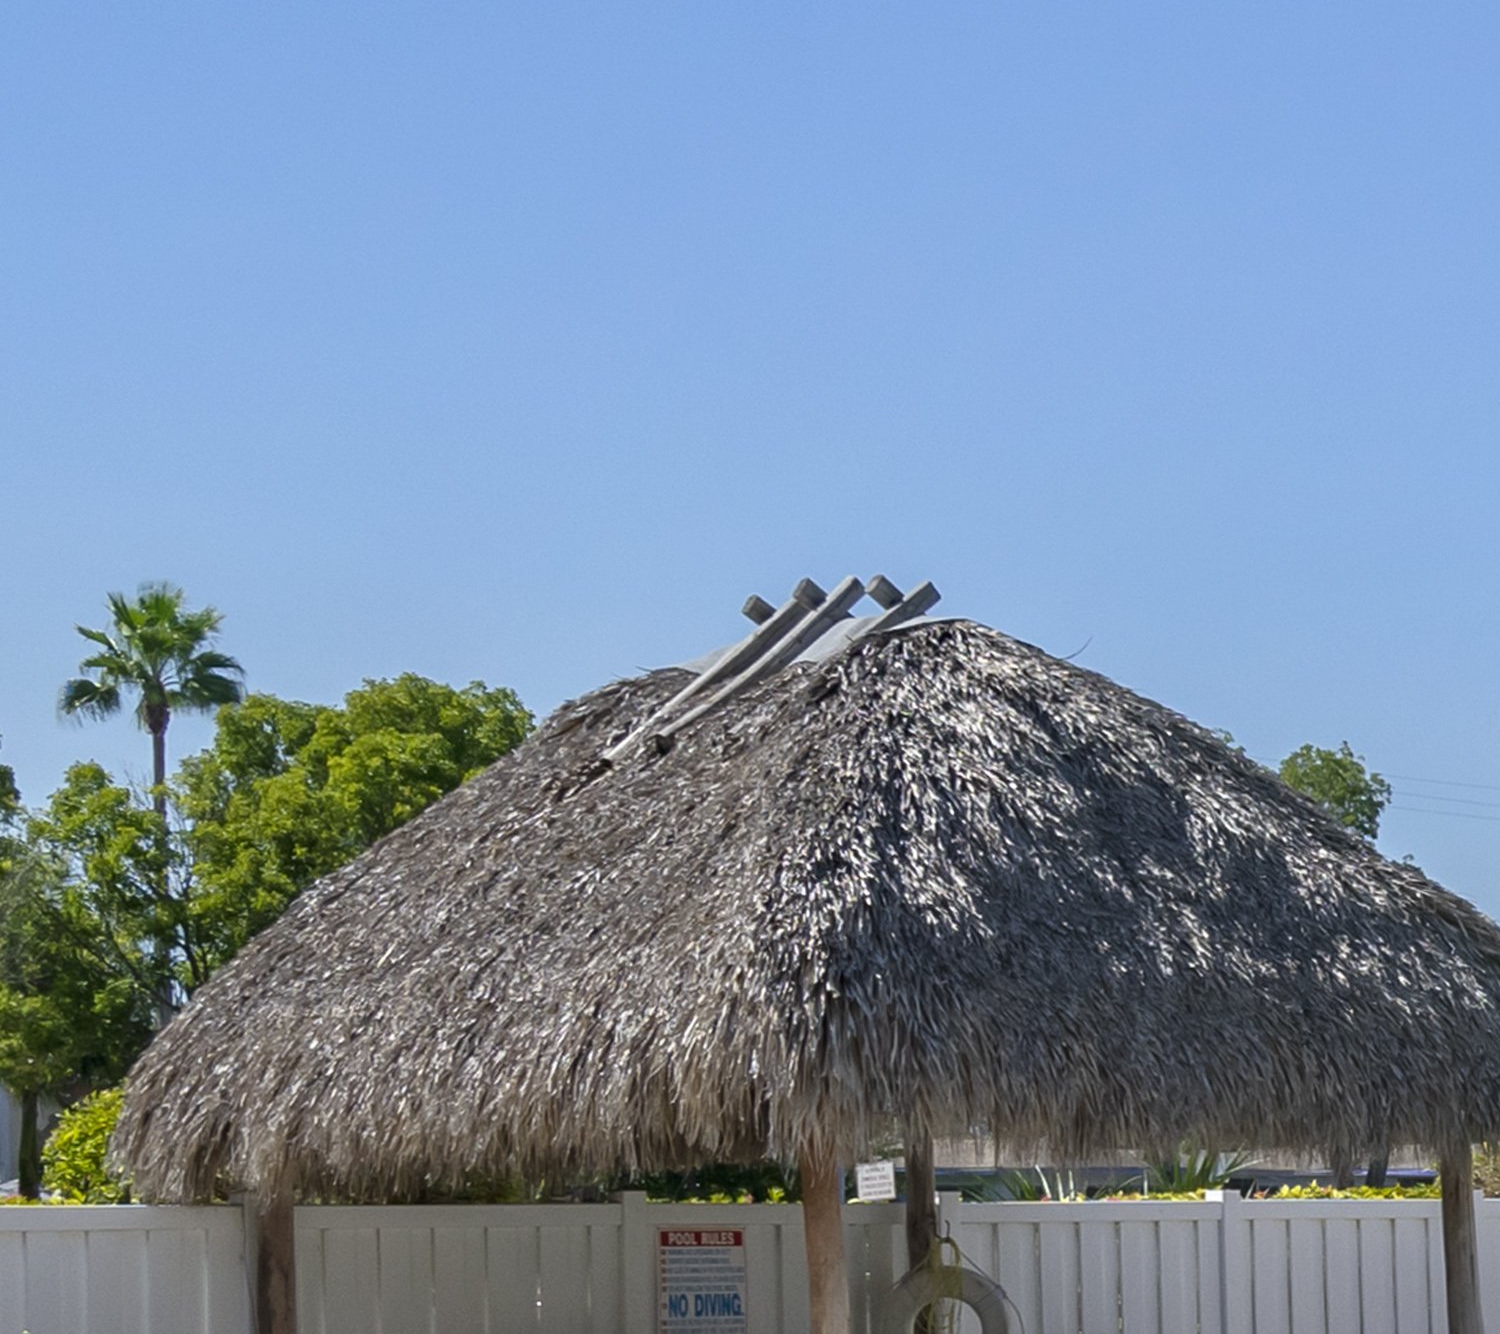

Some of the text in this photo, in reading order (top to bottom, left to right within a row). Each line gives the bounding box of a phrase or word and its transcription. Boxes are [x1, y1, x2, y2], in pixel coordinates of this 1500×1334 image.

[668, 1231, 735, 1246] POOL RULES
[668, 1293, 689, 1318] NO
